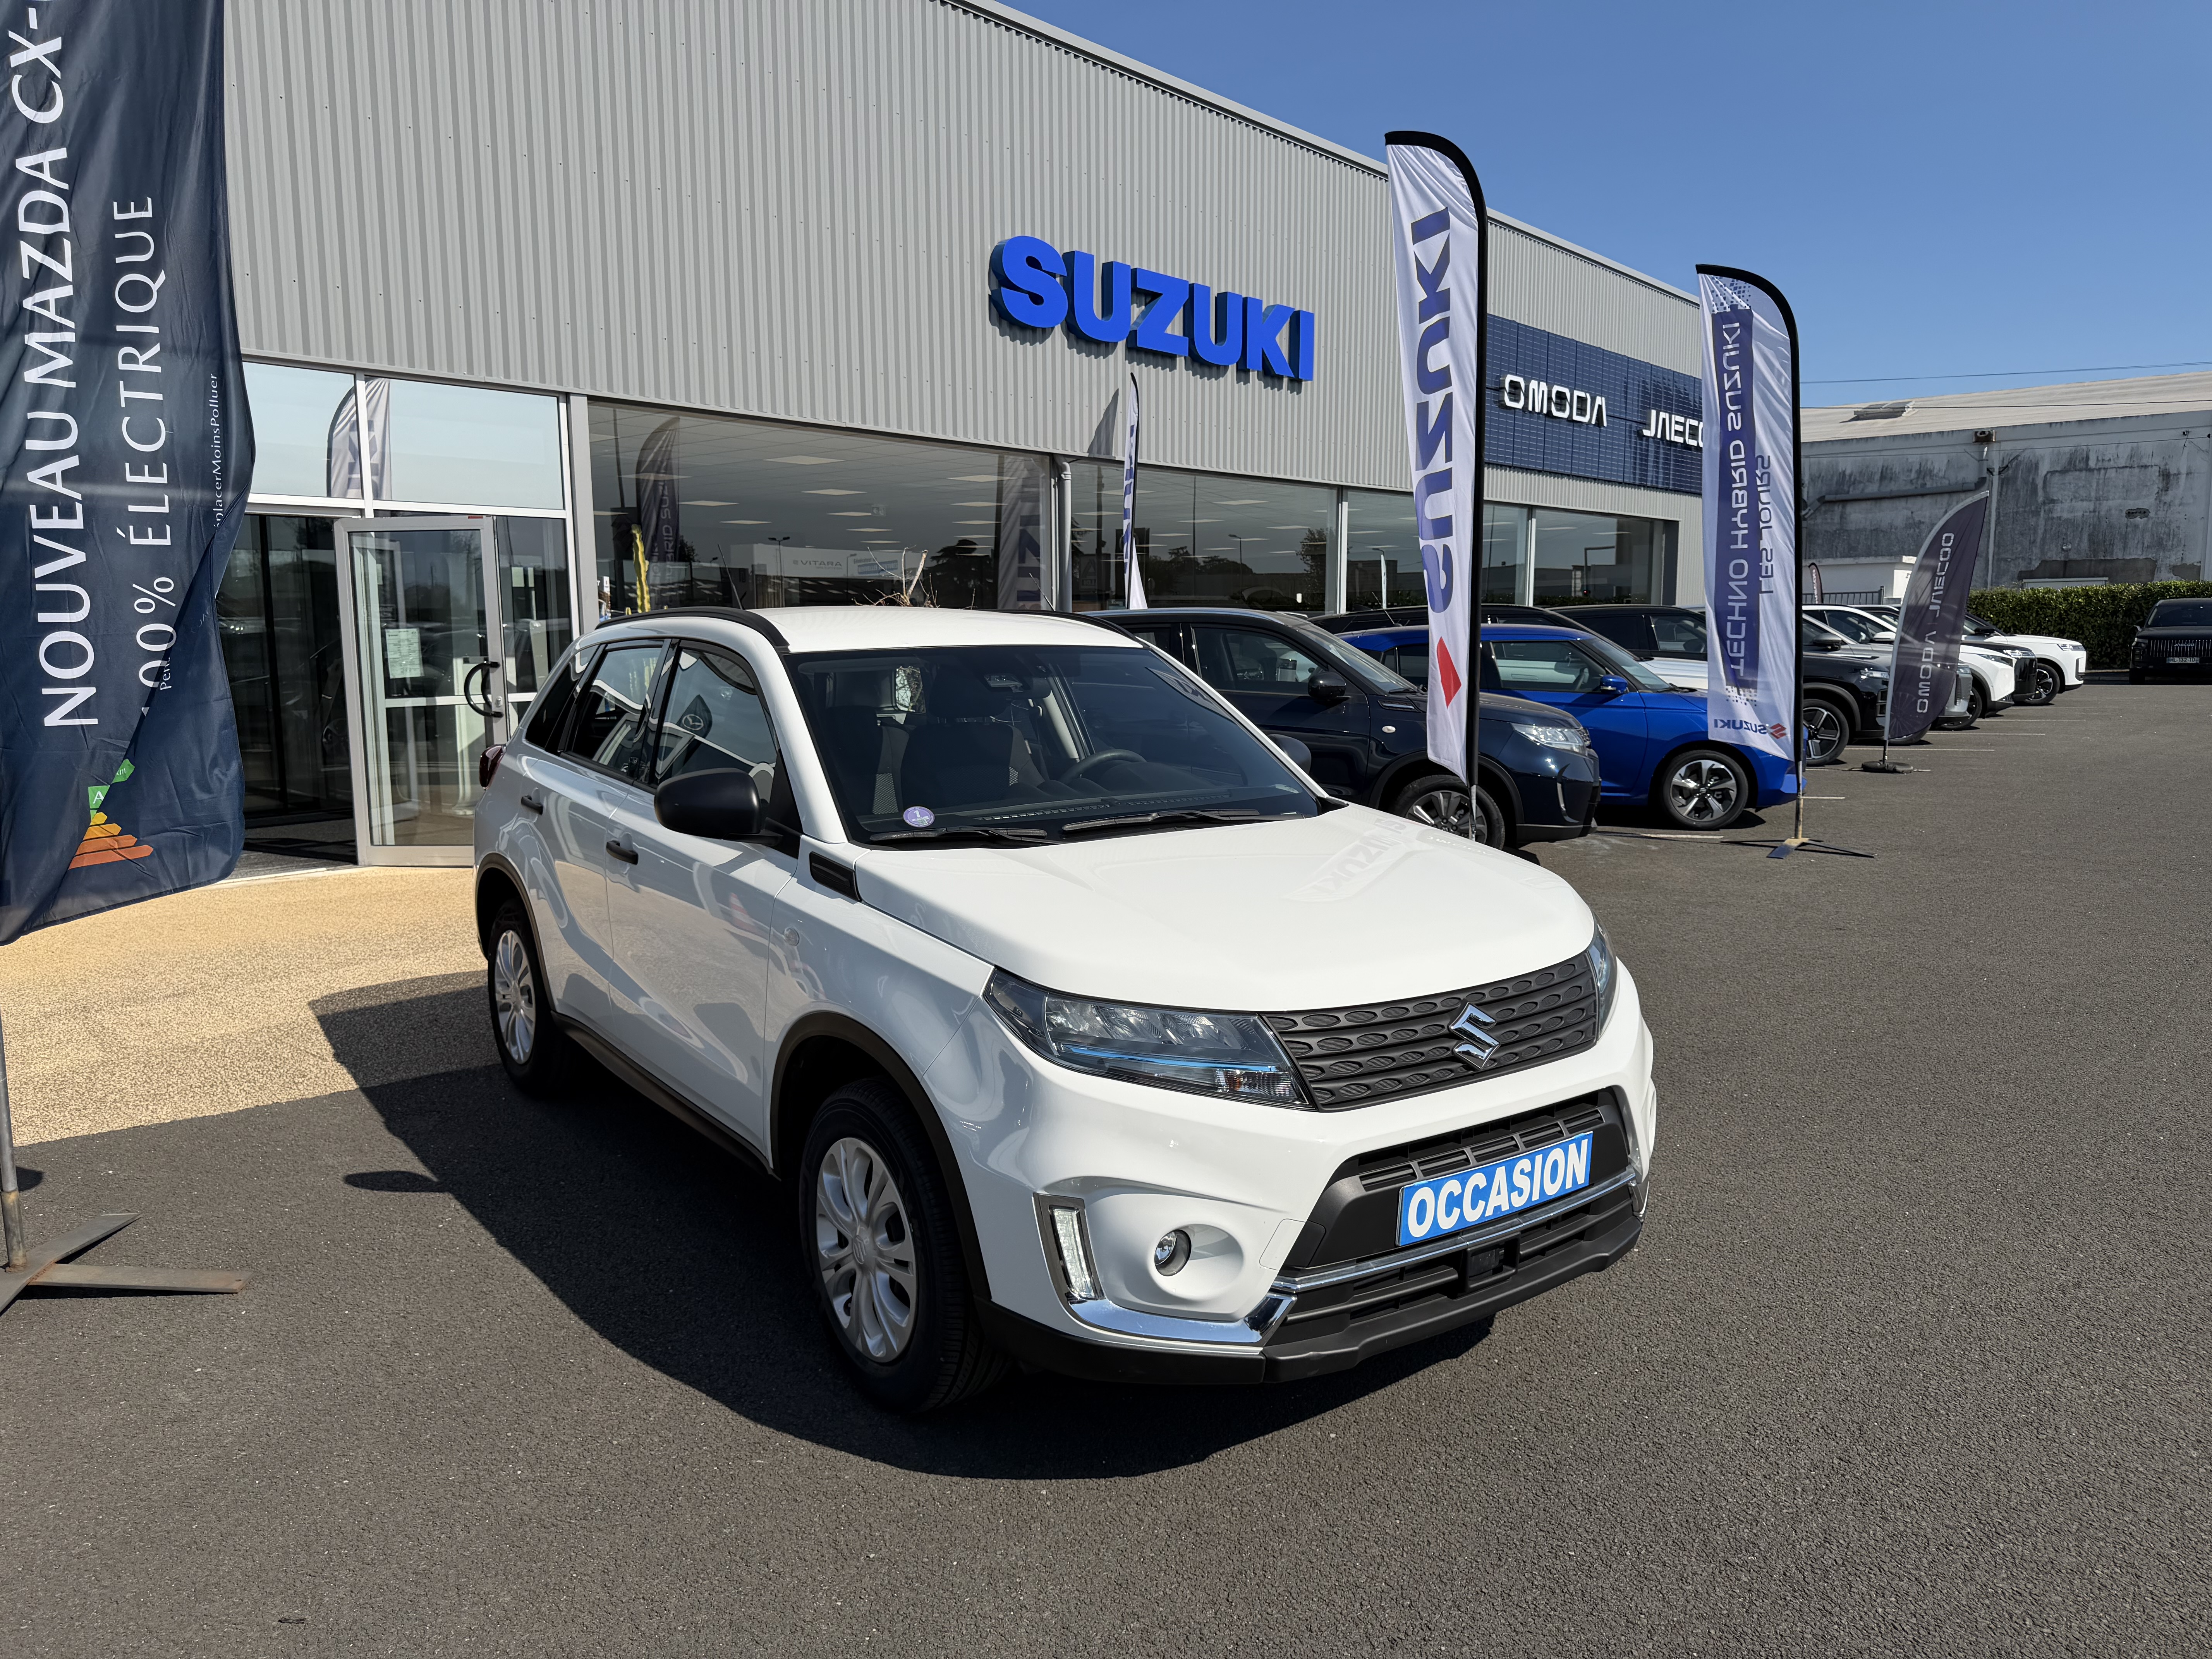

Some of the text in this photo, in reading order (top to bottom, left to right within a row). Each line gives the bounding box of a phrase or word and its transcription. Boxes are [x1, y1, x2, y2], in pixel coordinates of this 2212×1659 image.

[991, 236, 1314, 381] SUZUKI
[8, 0, 98, 727] NOUVEAU MAZDA CX-
[1504, 374, 1607, 427] OMODA
[113, 197, 177, 717] 00% ÉLECTRIQUE
[1642, 409, 1703, 447] JAEC
[1929, 533, 1954, 617] JAECOO
[160, 657, 172, 690] Pen
[1917, 631, 1936, 713] OMODA
[1408, 1139, 1588, 1238] OCCASION
